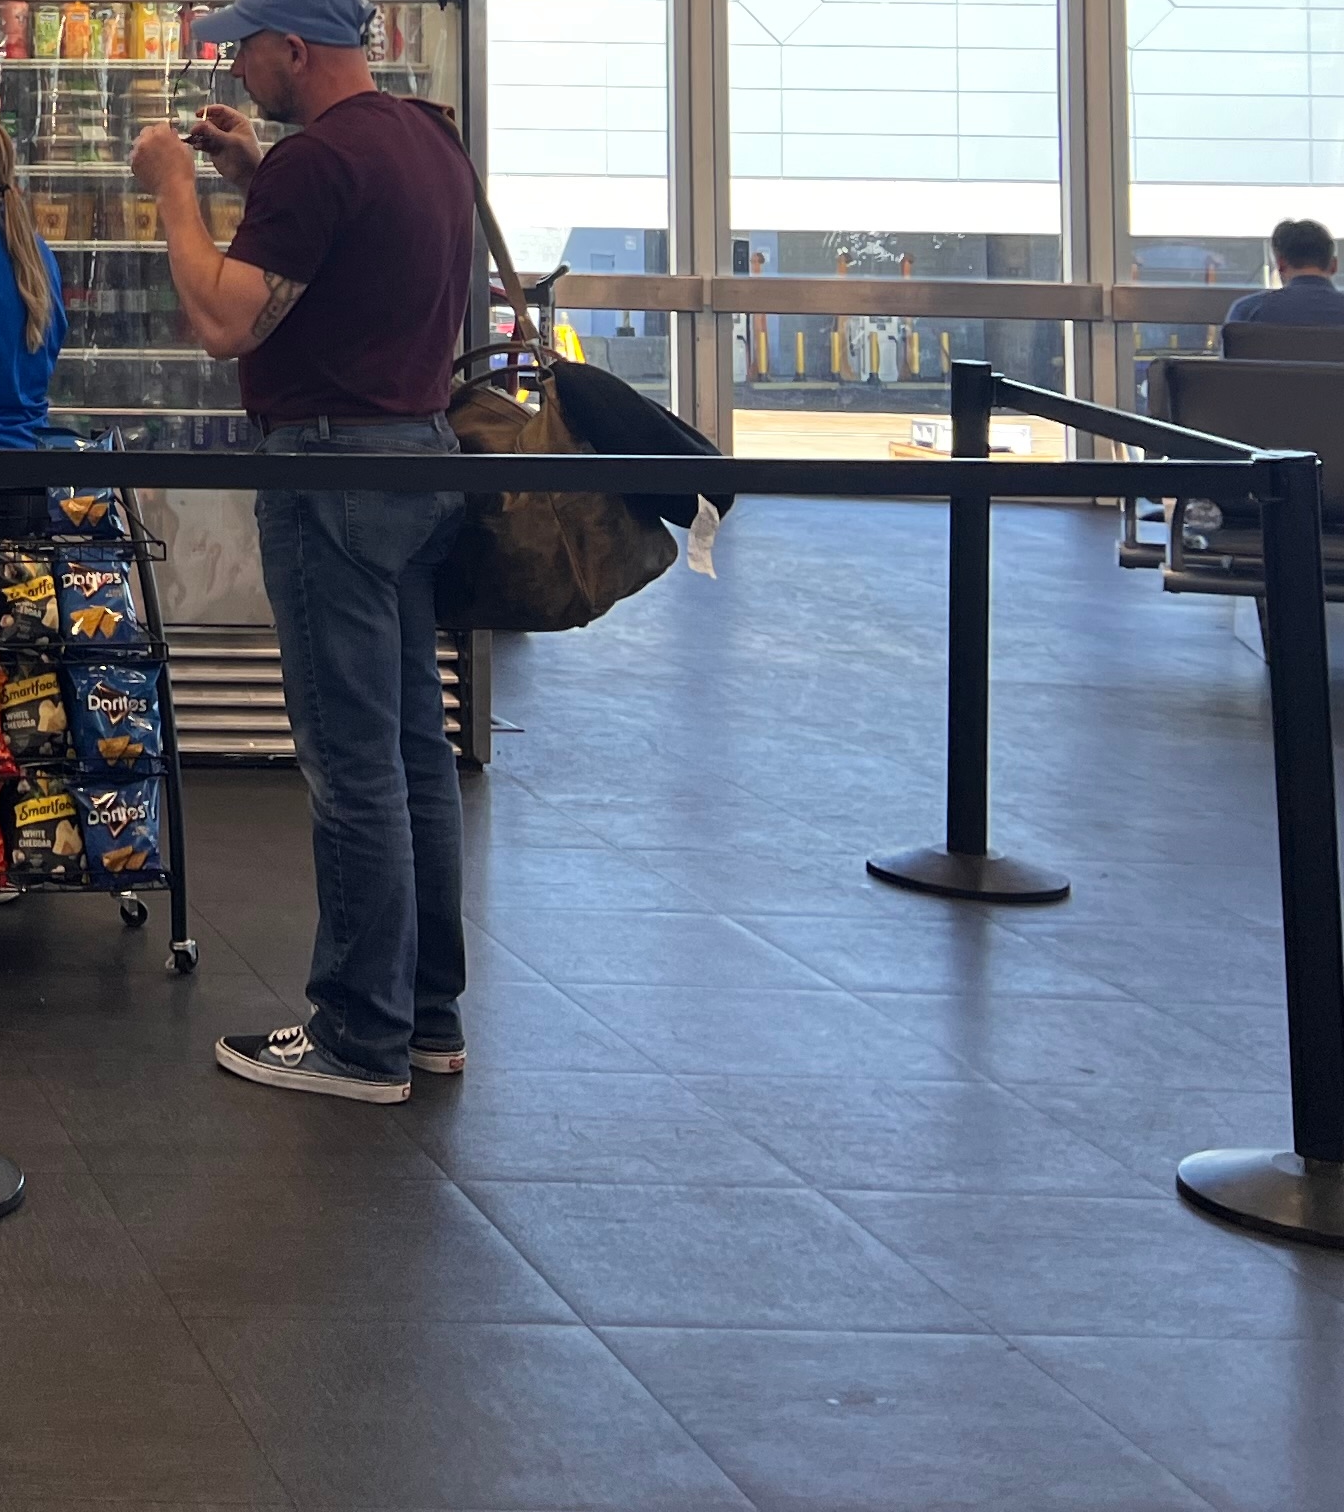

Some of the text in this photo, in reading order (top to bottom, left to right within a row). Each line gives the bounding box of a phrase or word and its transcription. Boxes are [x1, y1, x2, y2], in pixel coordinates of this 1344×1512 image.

[87, 694, 147, 713] Doritos
[5, 710, 30, 721] WHITE
[22, 830, 46, 838] WHITE
[18, 839, 52, 848] CHEDDAR
